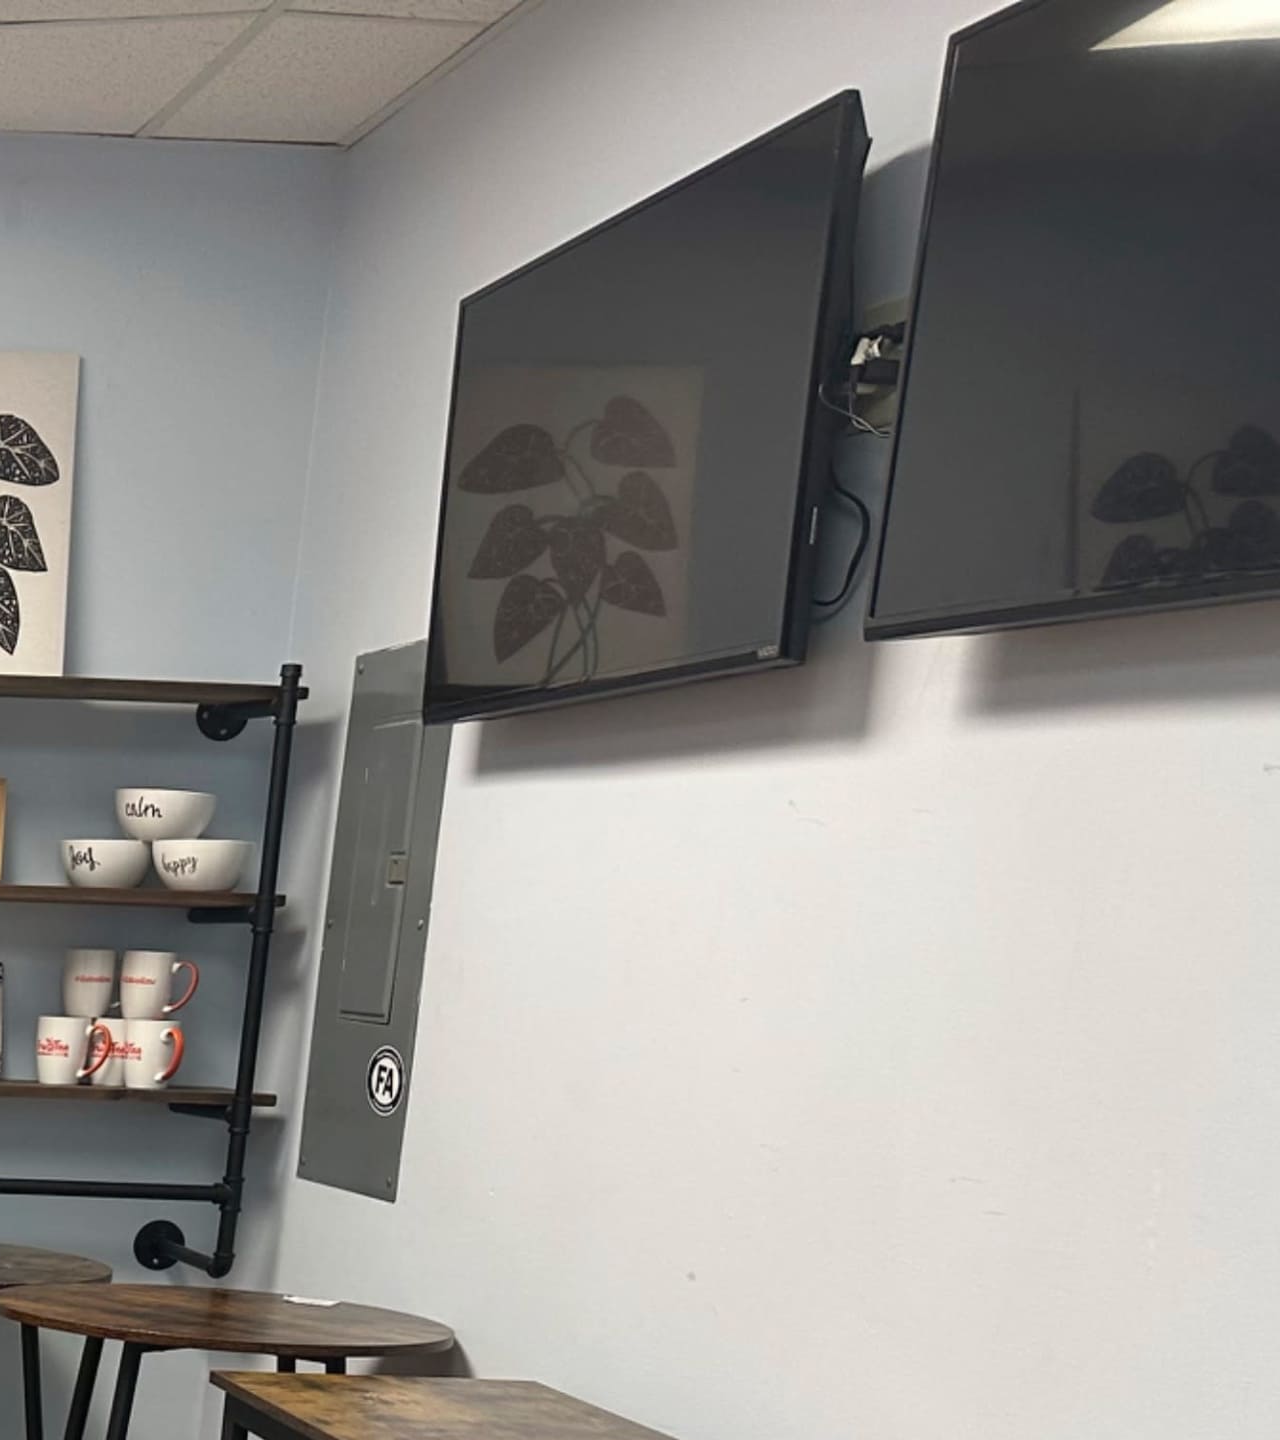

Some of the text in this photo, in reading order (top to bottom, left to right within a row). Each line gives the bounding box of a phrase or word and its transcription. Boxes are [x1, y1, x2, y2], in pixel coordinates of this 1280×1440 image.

[125, 796, 163, 819] calm
[161, 852, 199, 876] happy
[375, 1063, 394, 1099] FA
